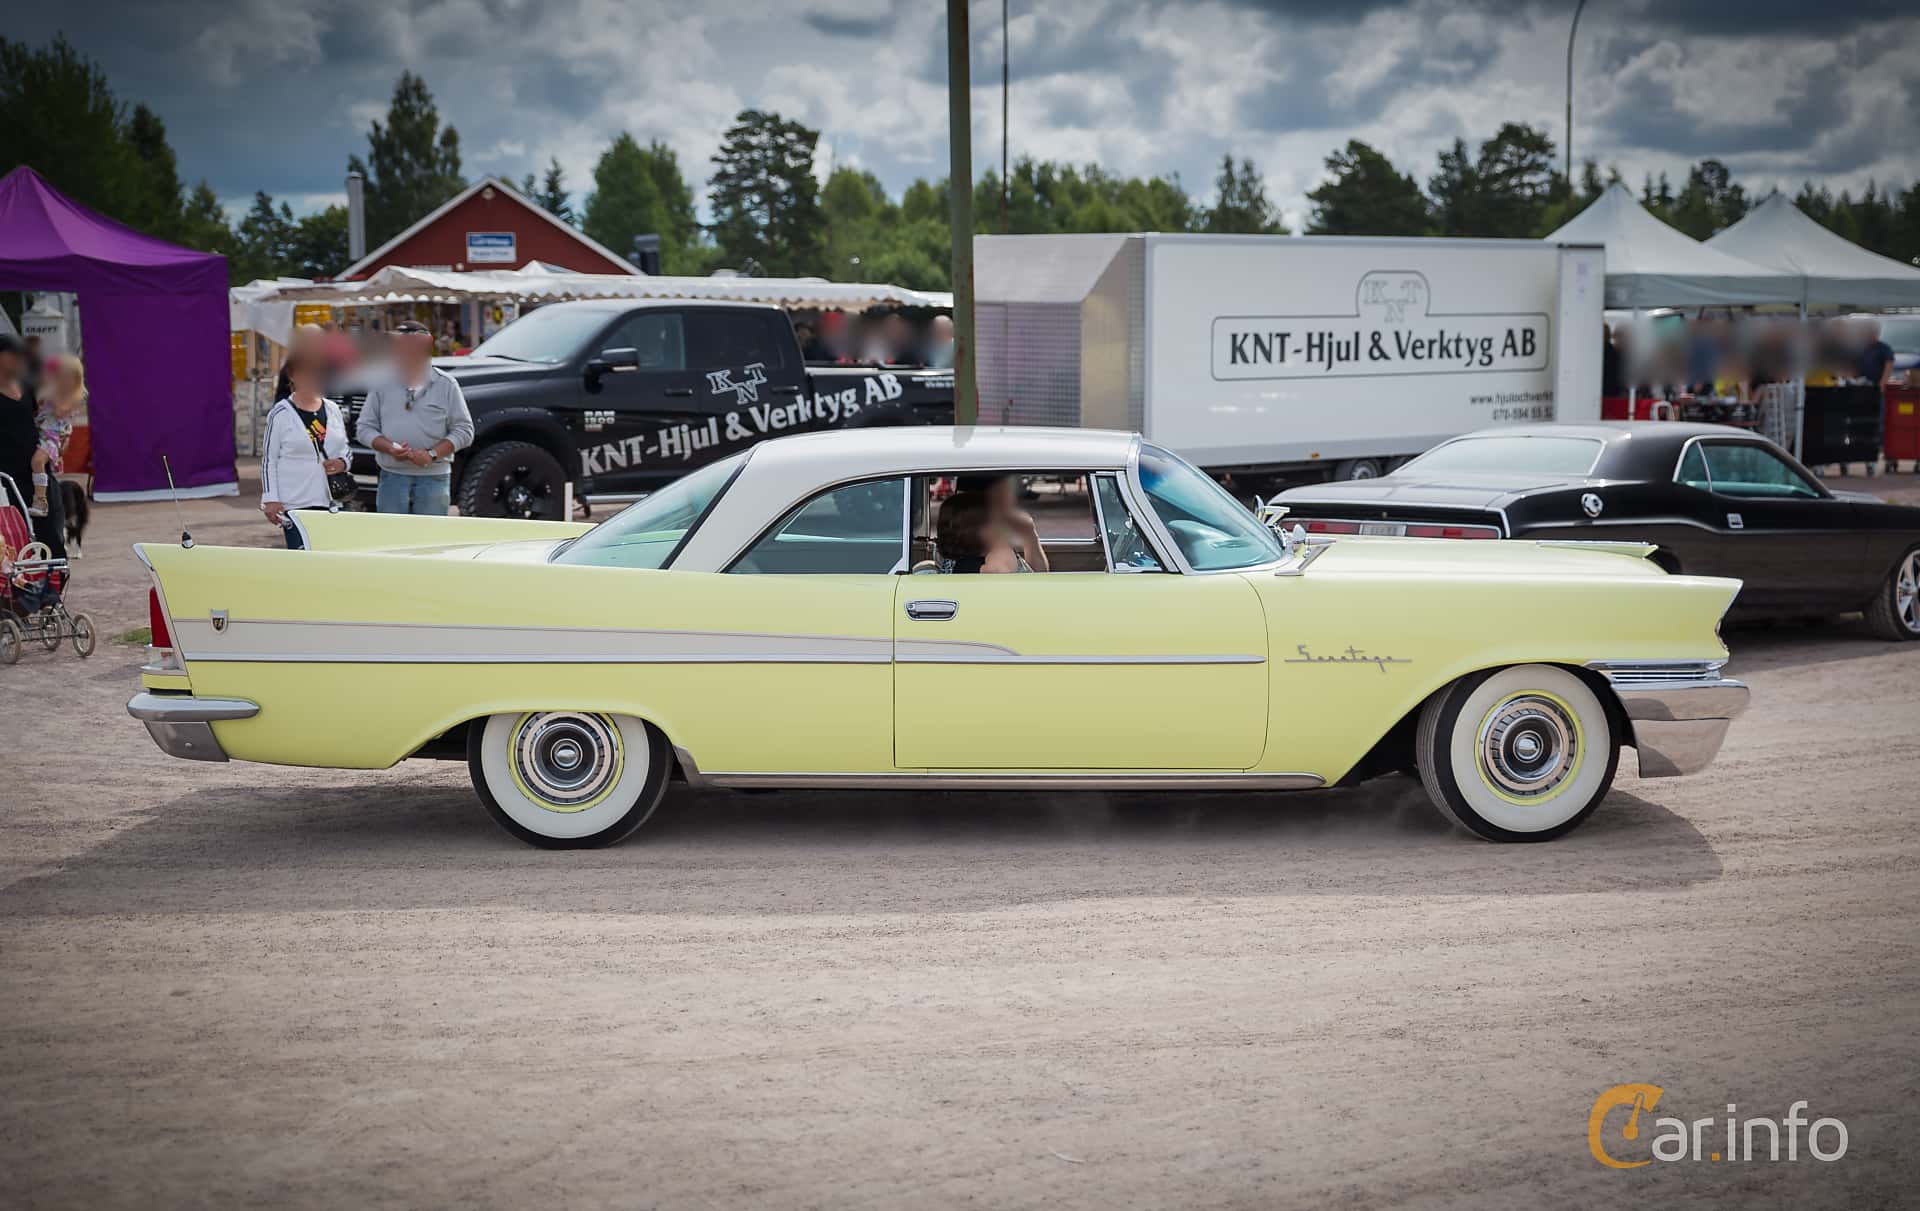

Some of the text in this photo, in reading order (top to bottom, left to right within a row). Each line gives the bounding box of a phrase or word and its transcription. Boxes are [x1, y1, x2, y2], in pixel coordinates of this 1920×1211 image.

[1229, 328, 1537, 371] KNT-Hjul & Verktyg AB
[578, 372, 904, 478] KNT-Hjul & Verktyg AB
